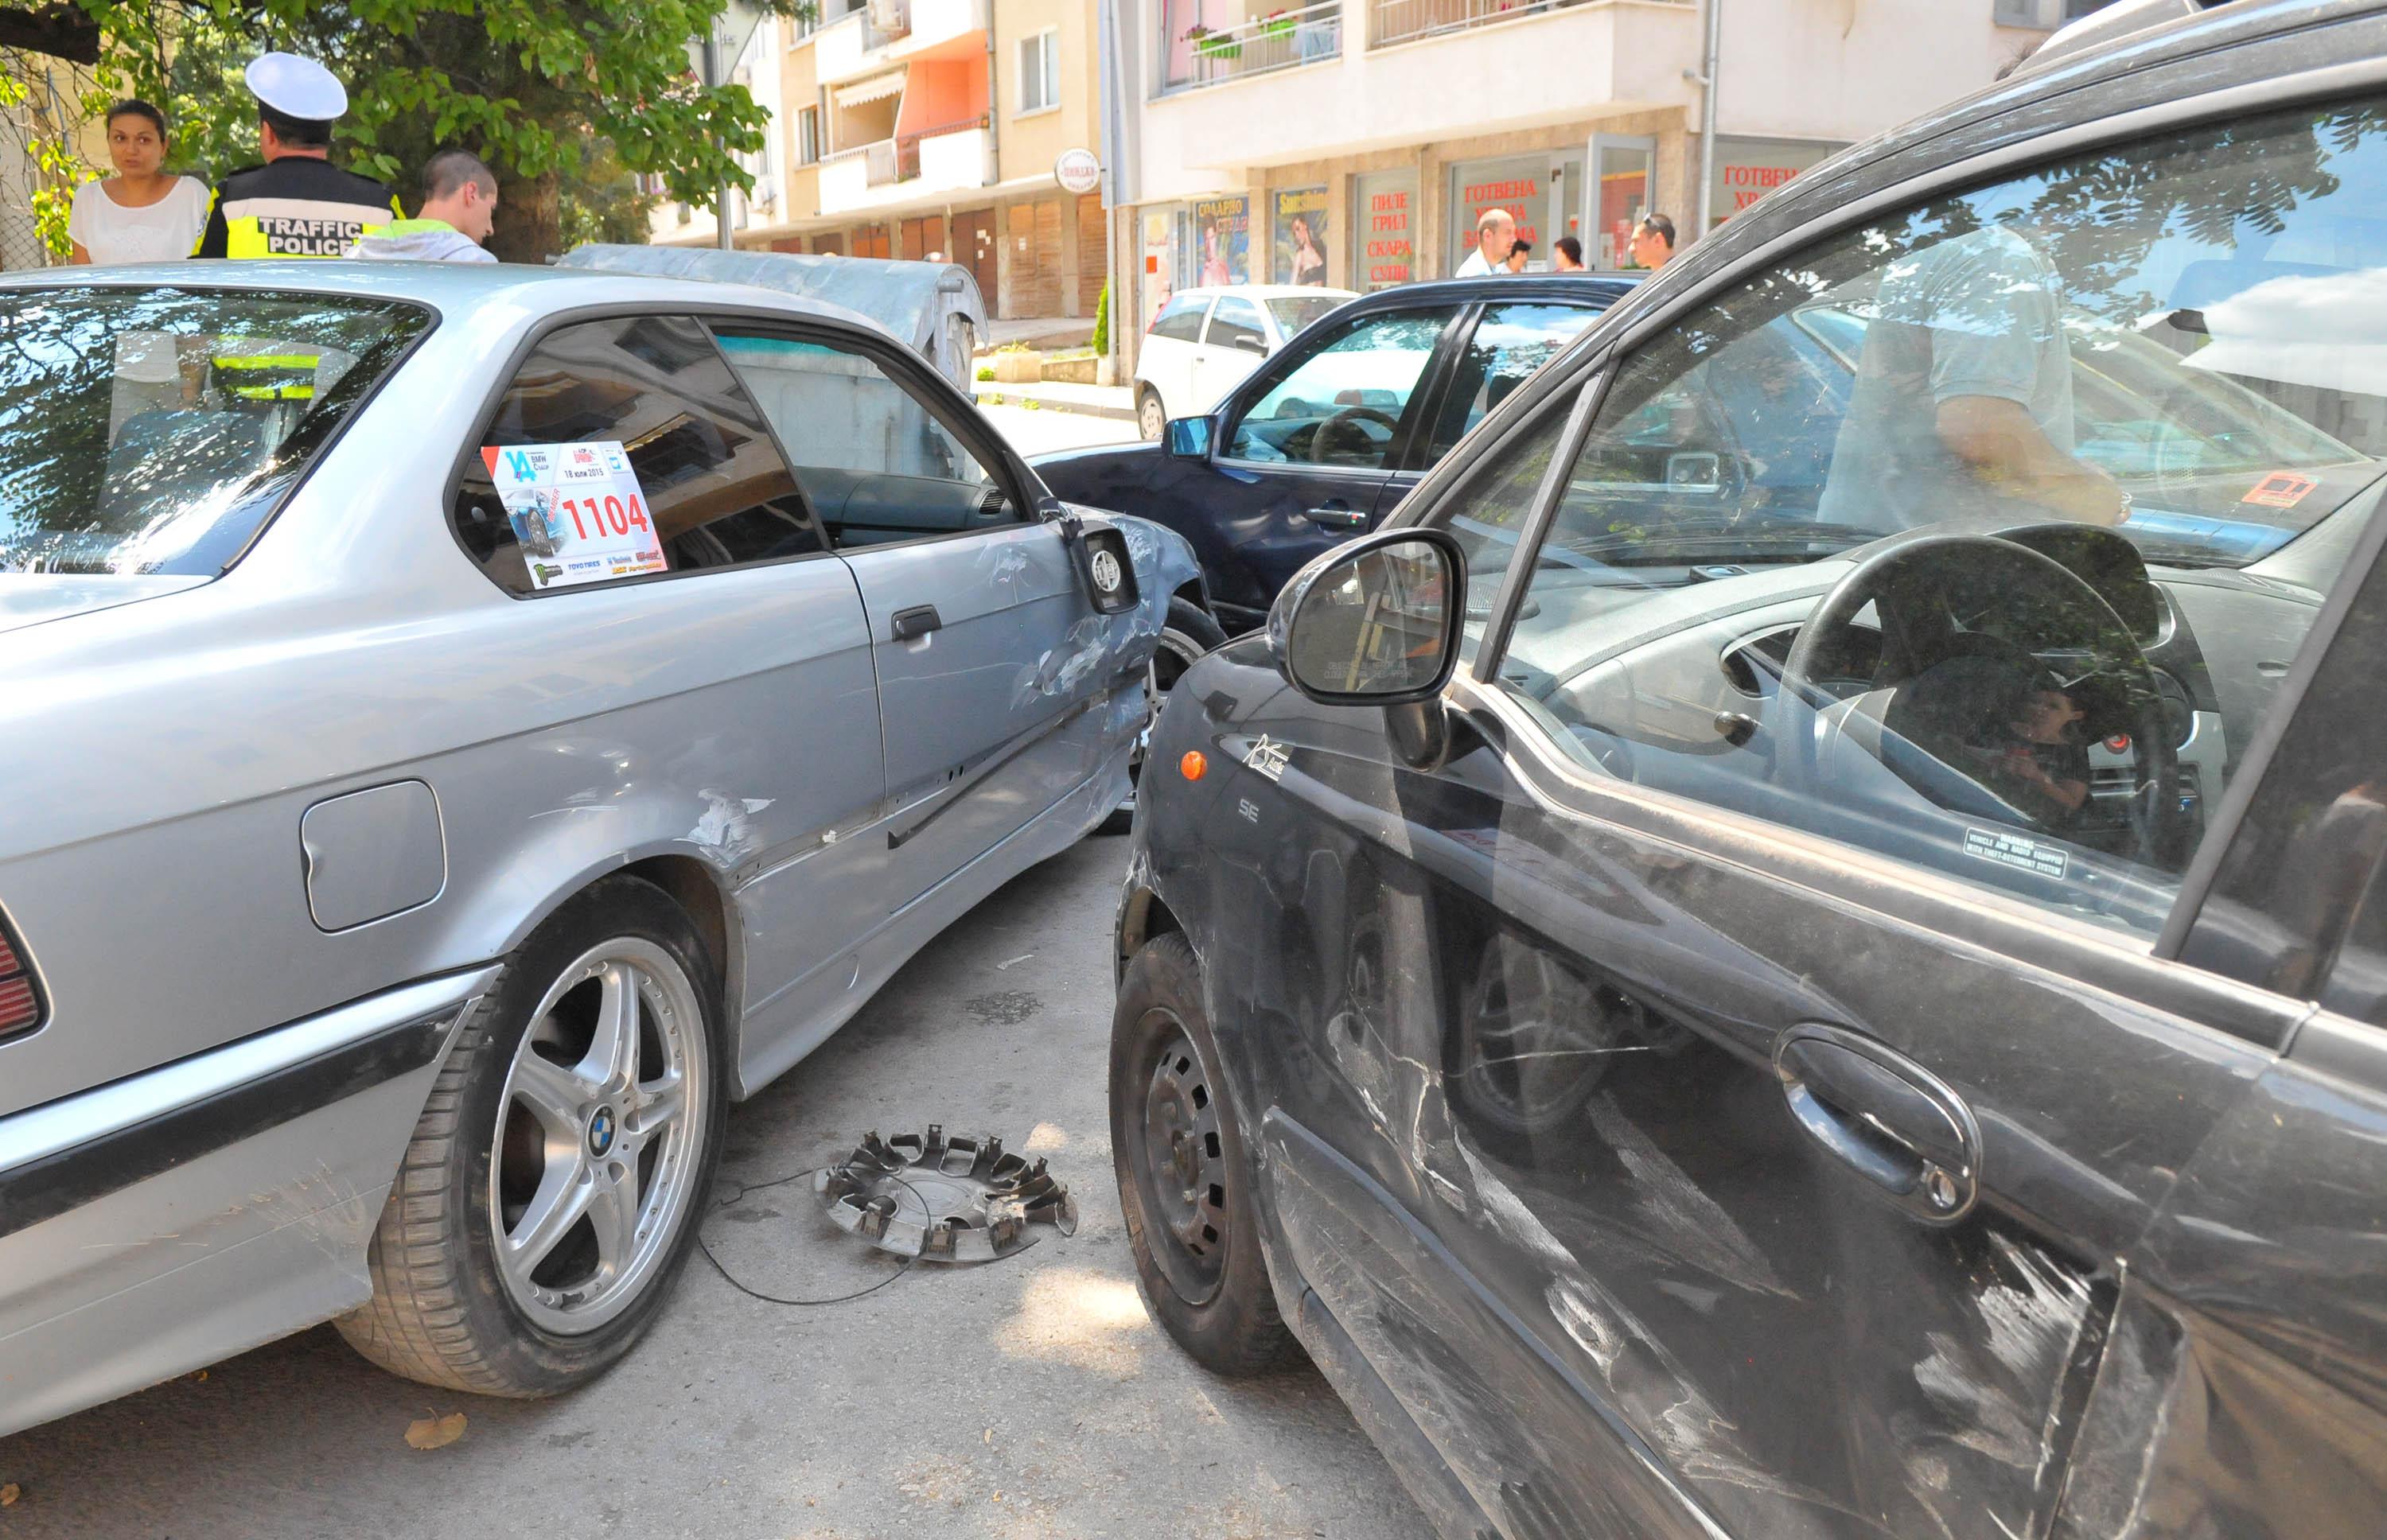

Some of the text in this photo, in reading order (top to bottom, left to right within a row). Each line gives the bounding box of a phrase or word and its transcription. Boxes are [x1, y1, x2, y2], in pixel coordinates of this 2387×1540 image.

[1724, 165, 1801, 186] ГОТВЕН
[1465, 178, 1537, 204] ГОТВЕНА
[1372, 192, 1410, 212] ПИЛЕ
[259, 217, 360, 238] TRAFFIC
[1372, 213, 1408, 231] ГРИЛ
[269, 238, 353, 255] POLICE
[1367, 239, 1413, 257] СКАРА
[1370, 264, 1409, 282] СУПИ
[588, 468, 604, 477] 2015
[562, 493, 648, 540] 1104
[568, 562, 584, 571] TOYO
[1238, 798, 1260, 822] SE
[1968, 834, 1994, 847] VEHICLE
[1995, 841, 2010, 851] AND
[1966, 843, 1983, 854] WITH
[2036, 861, 2062, 876] SYSTEM
